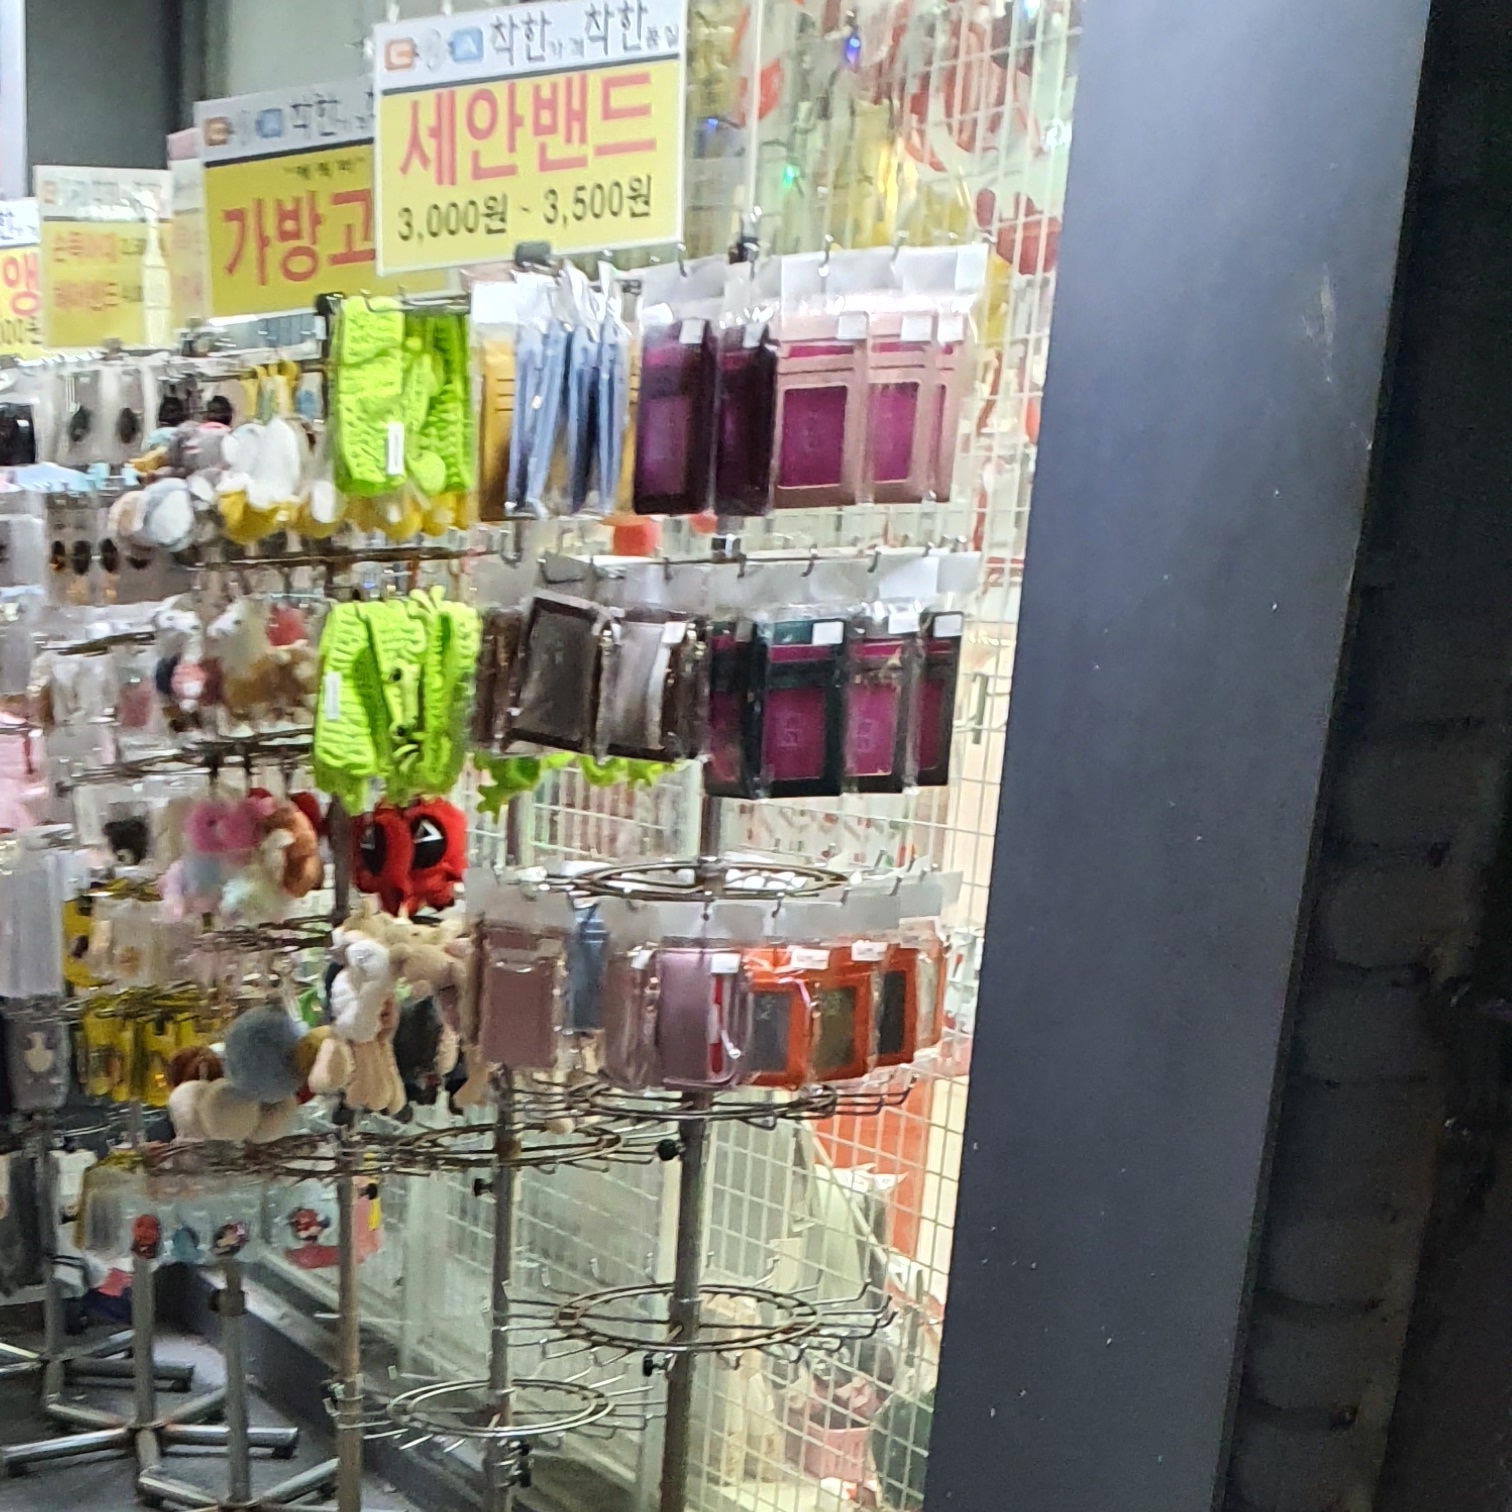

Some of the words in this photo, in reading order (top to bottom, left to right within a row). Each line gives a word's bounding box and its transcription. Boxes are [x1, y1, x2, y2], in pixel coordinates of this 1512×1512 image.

[399, 71, 657, 186] 세안밴드
[222, 188, 375, 286] 가방고
[398, 192, 508, 244] 3,000원
[543, 174, 652, 227] 3,500원
